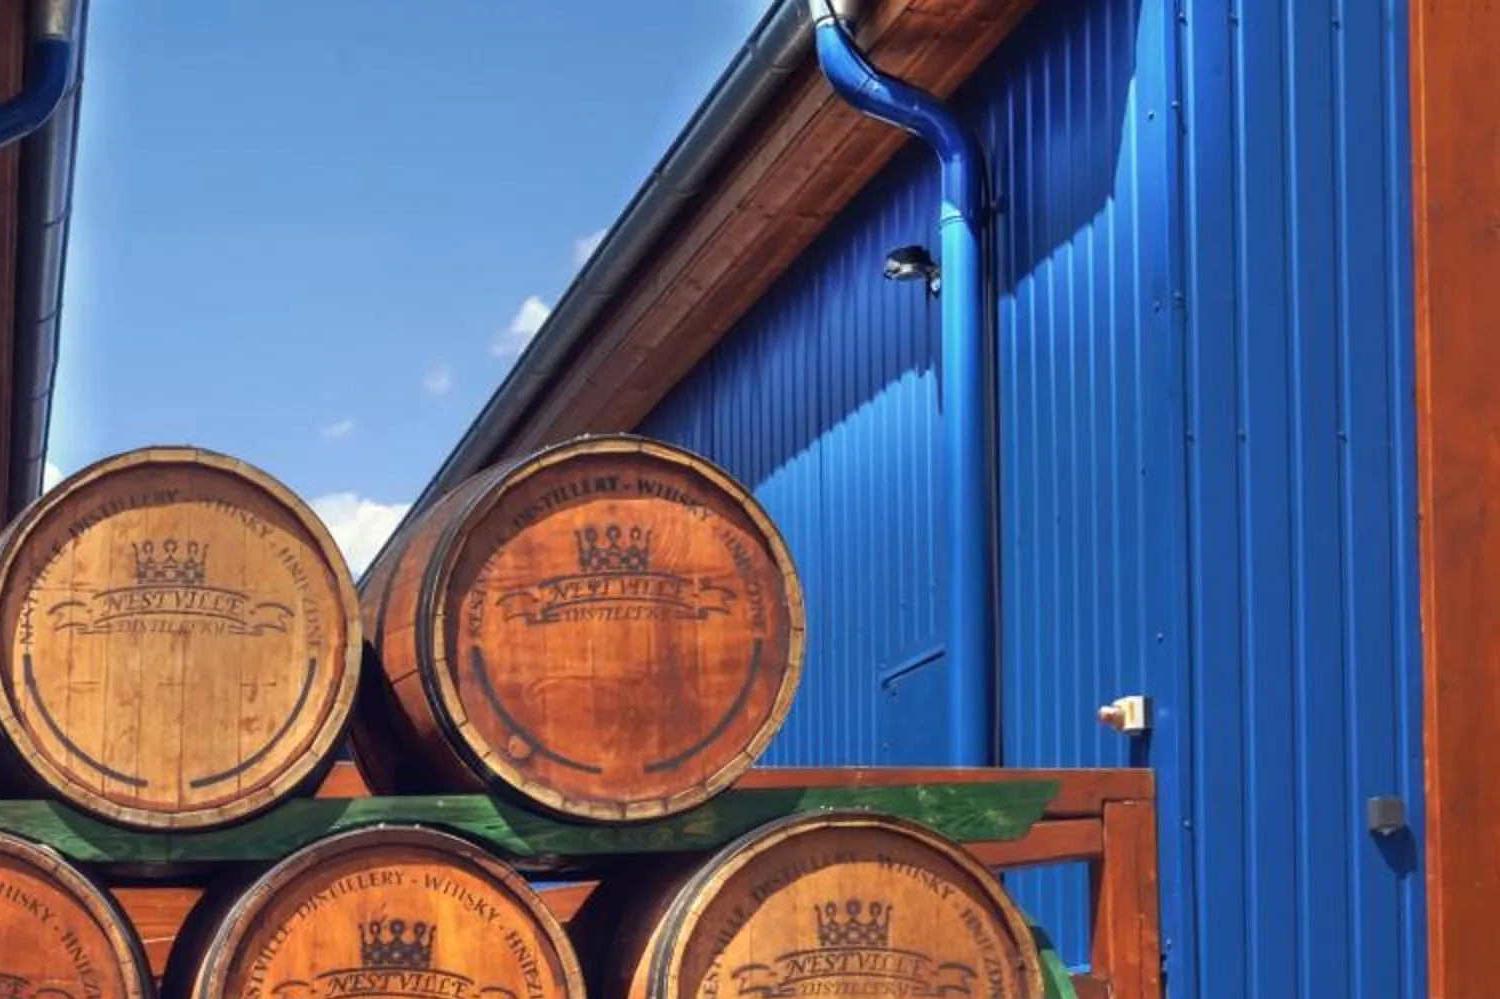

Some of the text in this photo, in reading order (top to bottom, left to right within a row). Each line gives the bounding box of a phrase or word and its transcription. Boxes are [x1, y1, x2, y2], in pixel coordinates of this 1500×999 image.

[297, 869, 406, 922] DISTILLERY
[423, 873, 500, 925] WHISKY
[787, 952, 922, 977] NESTVILLE
[325, 972, 468, 999] NESTVILLE
